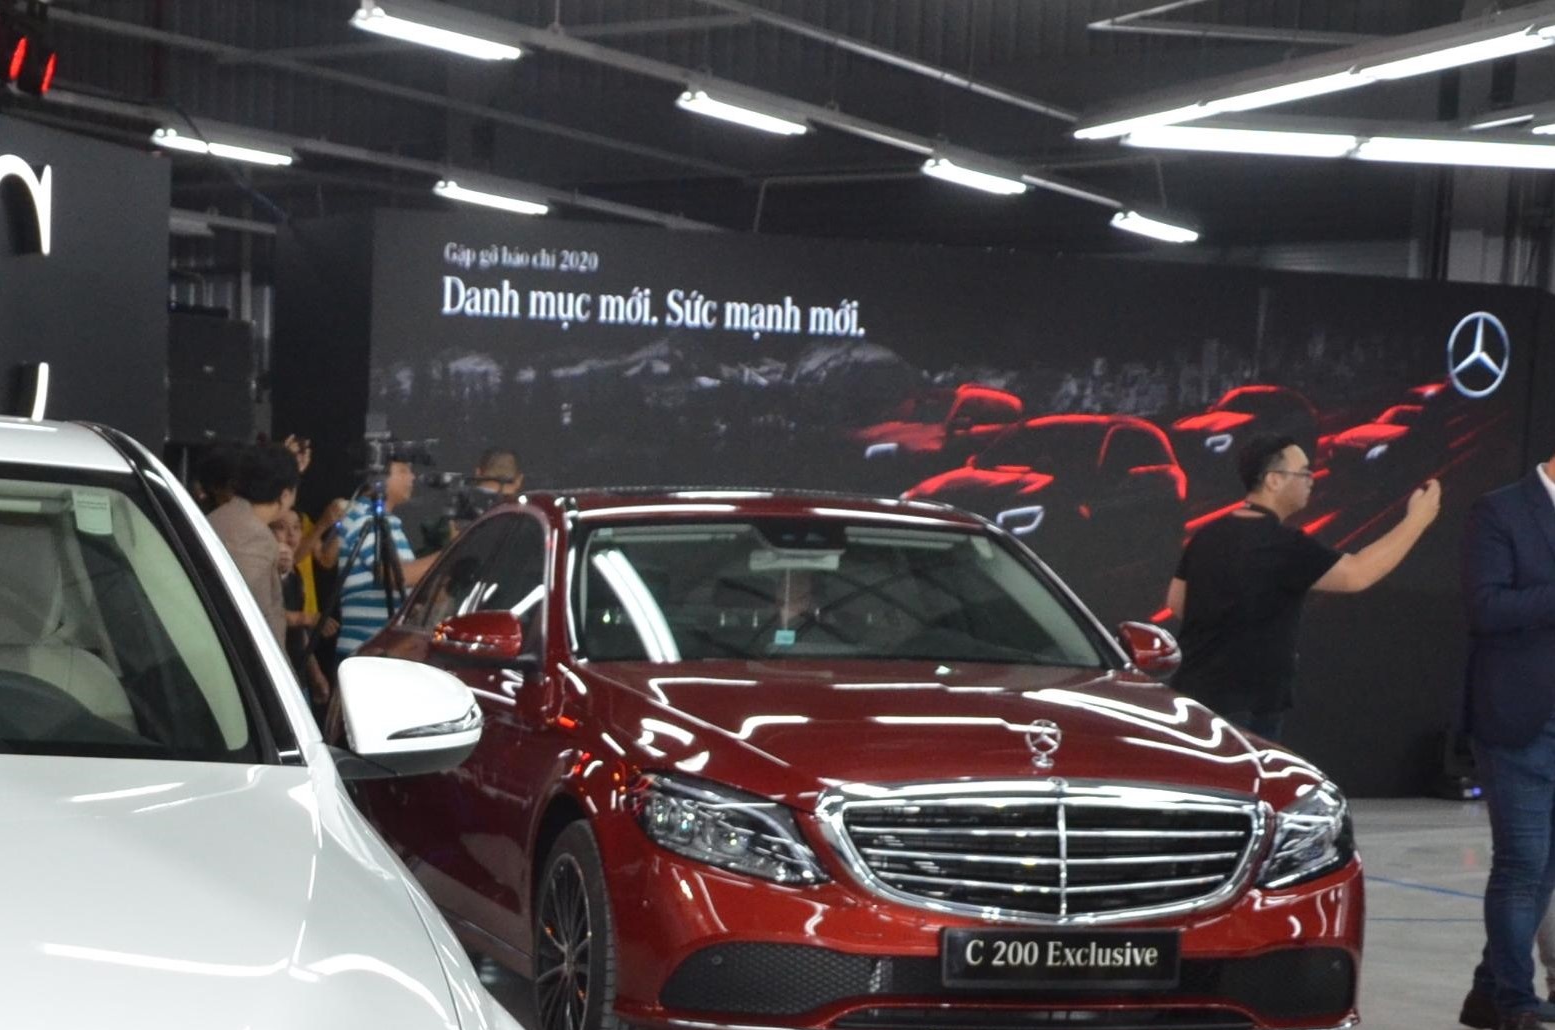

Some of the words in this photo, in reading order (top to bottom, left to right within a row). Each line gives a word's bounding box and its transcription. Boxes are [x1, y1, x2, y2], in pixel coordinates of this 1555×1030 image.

[559, 249, 599, 272] 2020
[442, 275, 520, 318] Danh
[529, 289, 591, 331] mục
[599, 286, 659, 325] mới.
[665, 288, 717, 329] Sức
[724, 295, 801, 341] mạnh
[809, 298, 866, 337] mới.
[965, 939, 984, 967] C
[992, 940, 1039, 967] 200
[1047, 940, 1159, 967] Exclusive
